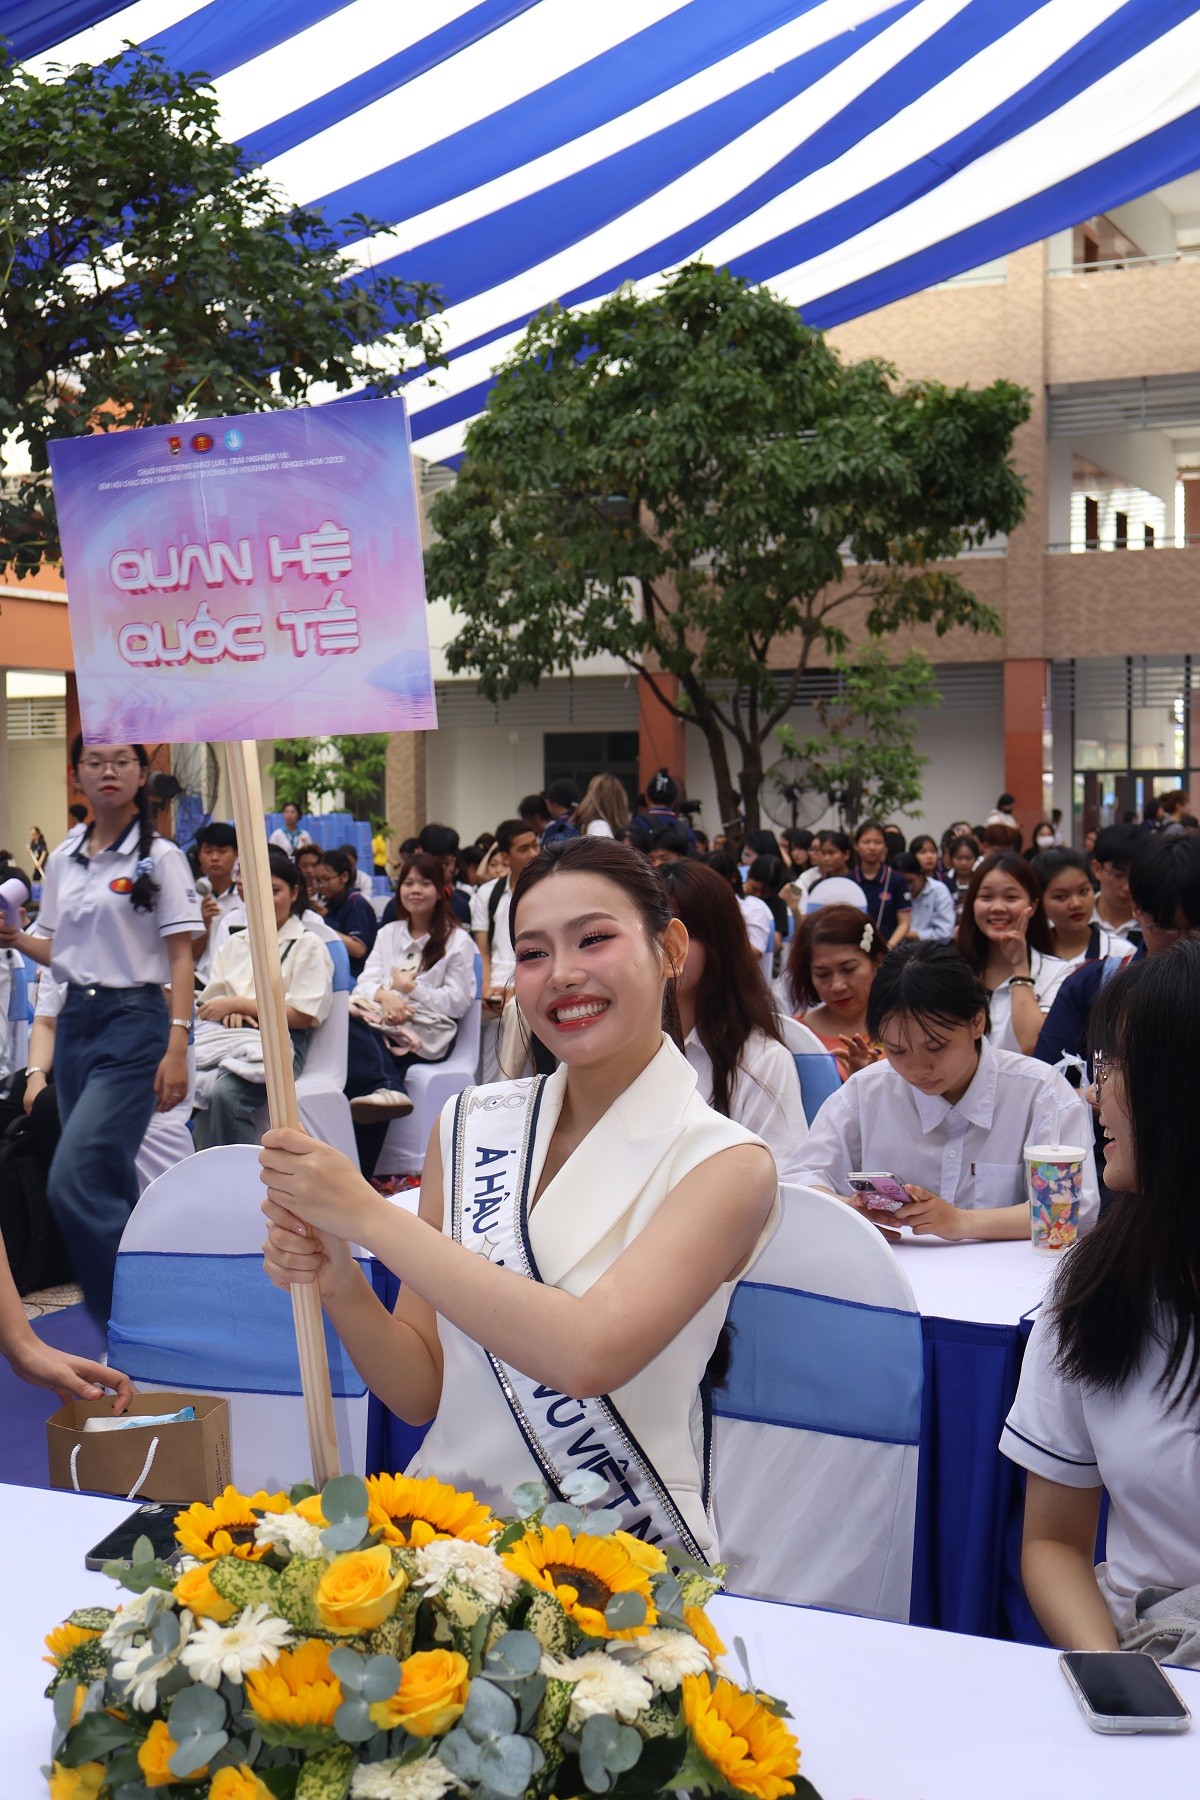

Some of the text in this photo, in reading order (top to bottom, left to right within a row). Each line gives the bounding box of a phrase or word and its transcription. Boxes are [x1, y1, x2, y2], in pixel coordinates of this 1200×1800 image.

[110, 520, 352, 595] QUAN HỆ
[118, 589, 360, 667] QUỐC TẾ
[464, 1171, 511, 1234] HẬU
